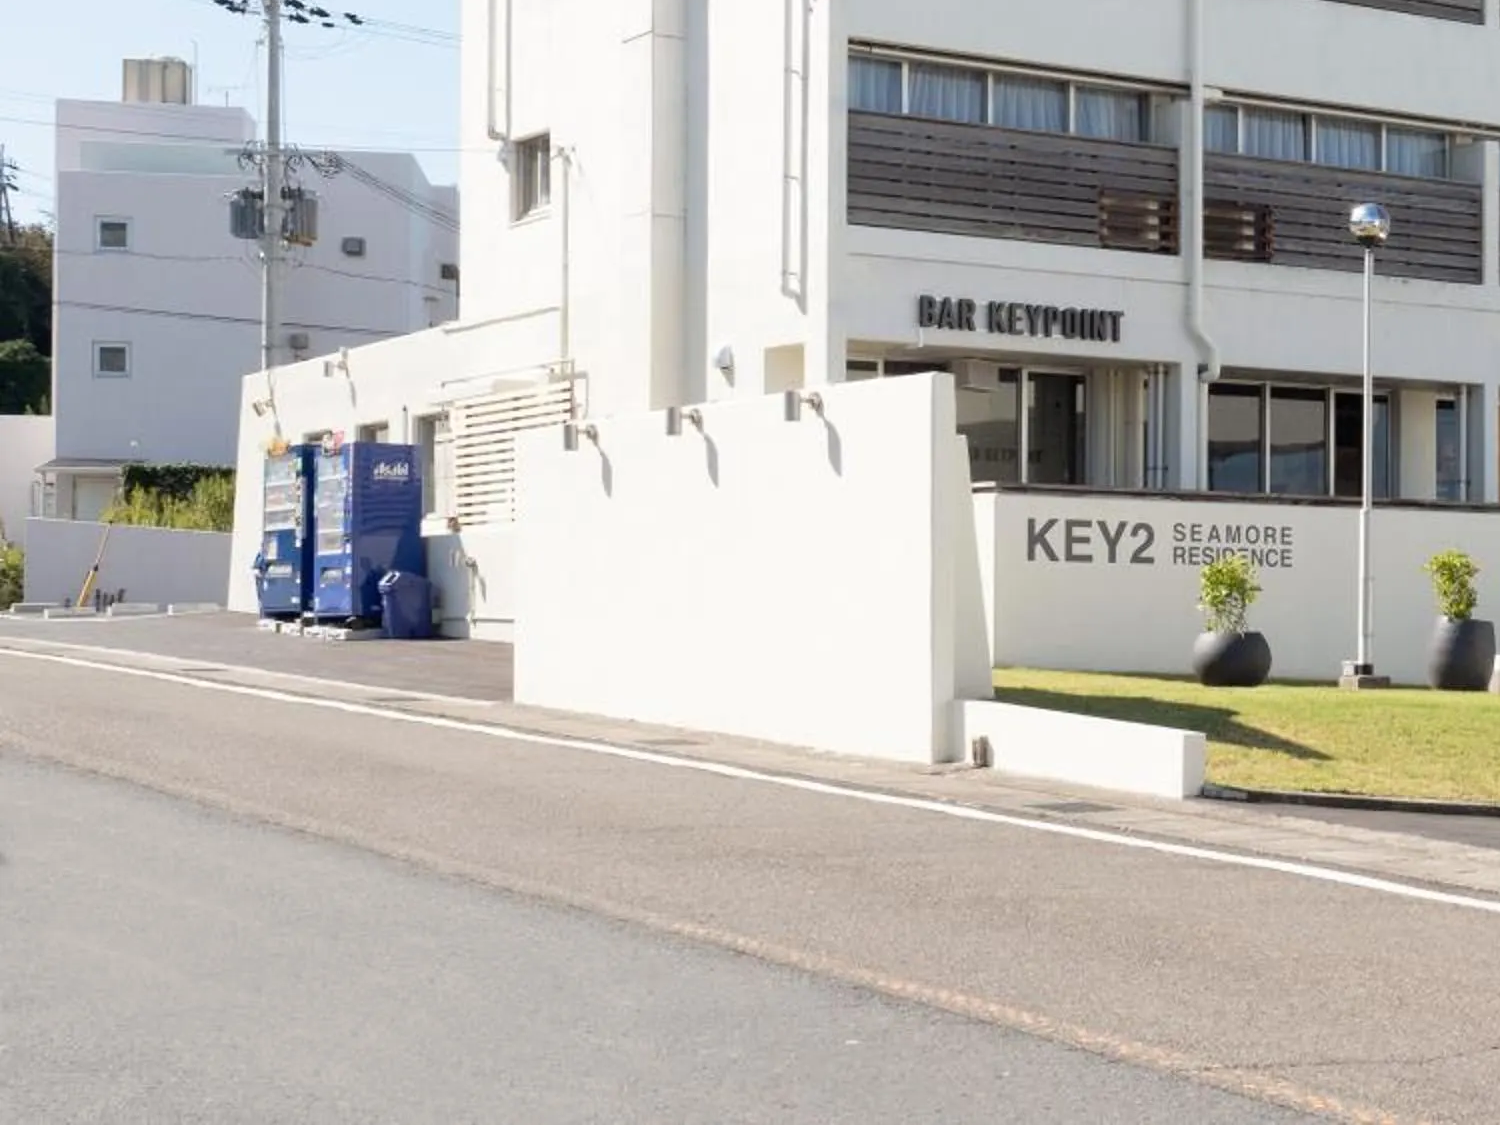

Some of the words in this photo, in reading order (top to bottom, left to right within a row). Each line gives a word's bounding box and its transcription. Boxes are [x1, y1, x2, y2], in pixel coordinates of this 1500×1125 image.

[918, 294, 977, 331] BAR
[987, 300, 1125, 342] KEYPOINT
[1026, 518, 1155, 564] KEY2
[1172, 523, 1293, 545] SEAMORE
